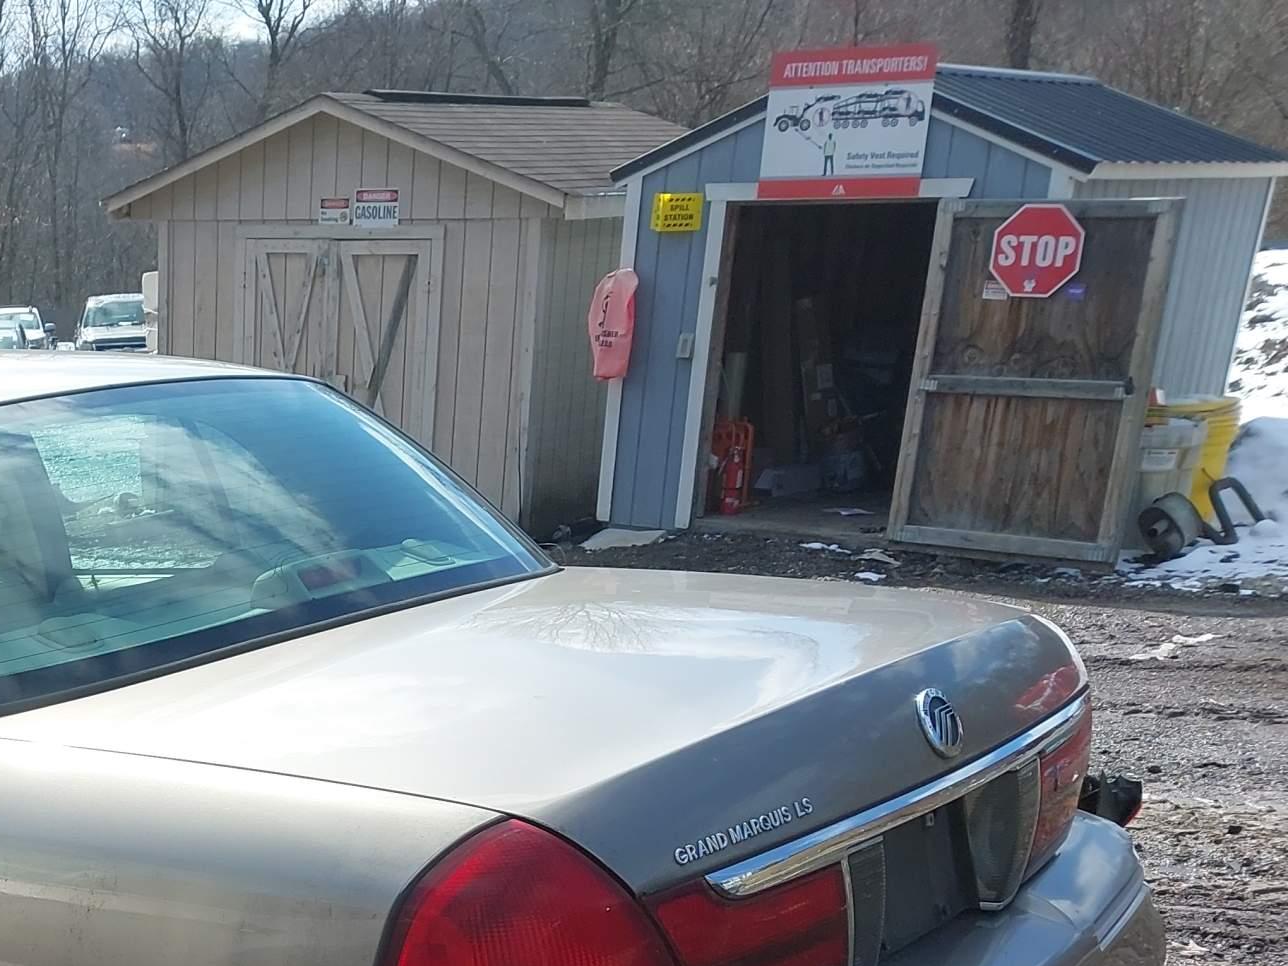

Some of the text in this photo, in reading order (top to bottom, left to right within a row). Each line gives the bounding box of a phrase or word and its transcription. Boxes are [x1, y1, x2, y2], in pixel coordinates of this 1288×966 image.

[783, 55, 928, 78] ATTENTION TRANSPORTERS!
[870, 152, 887, 160] Vest
[354, 205, 398, 219] GASOLINE
[997, 234, 1076, 267] STOP
[674, 797, 813, 865] GRAND MARQUIS LS
